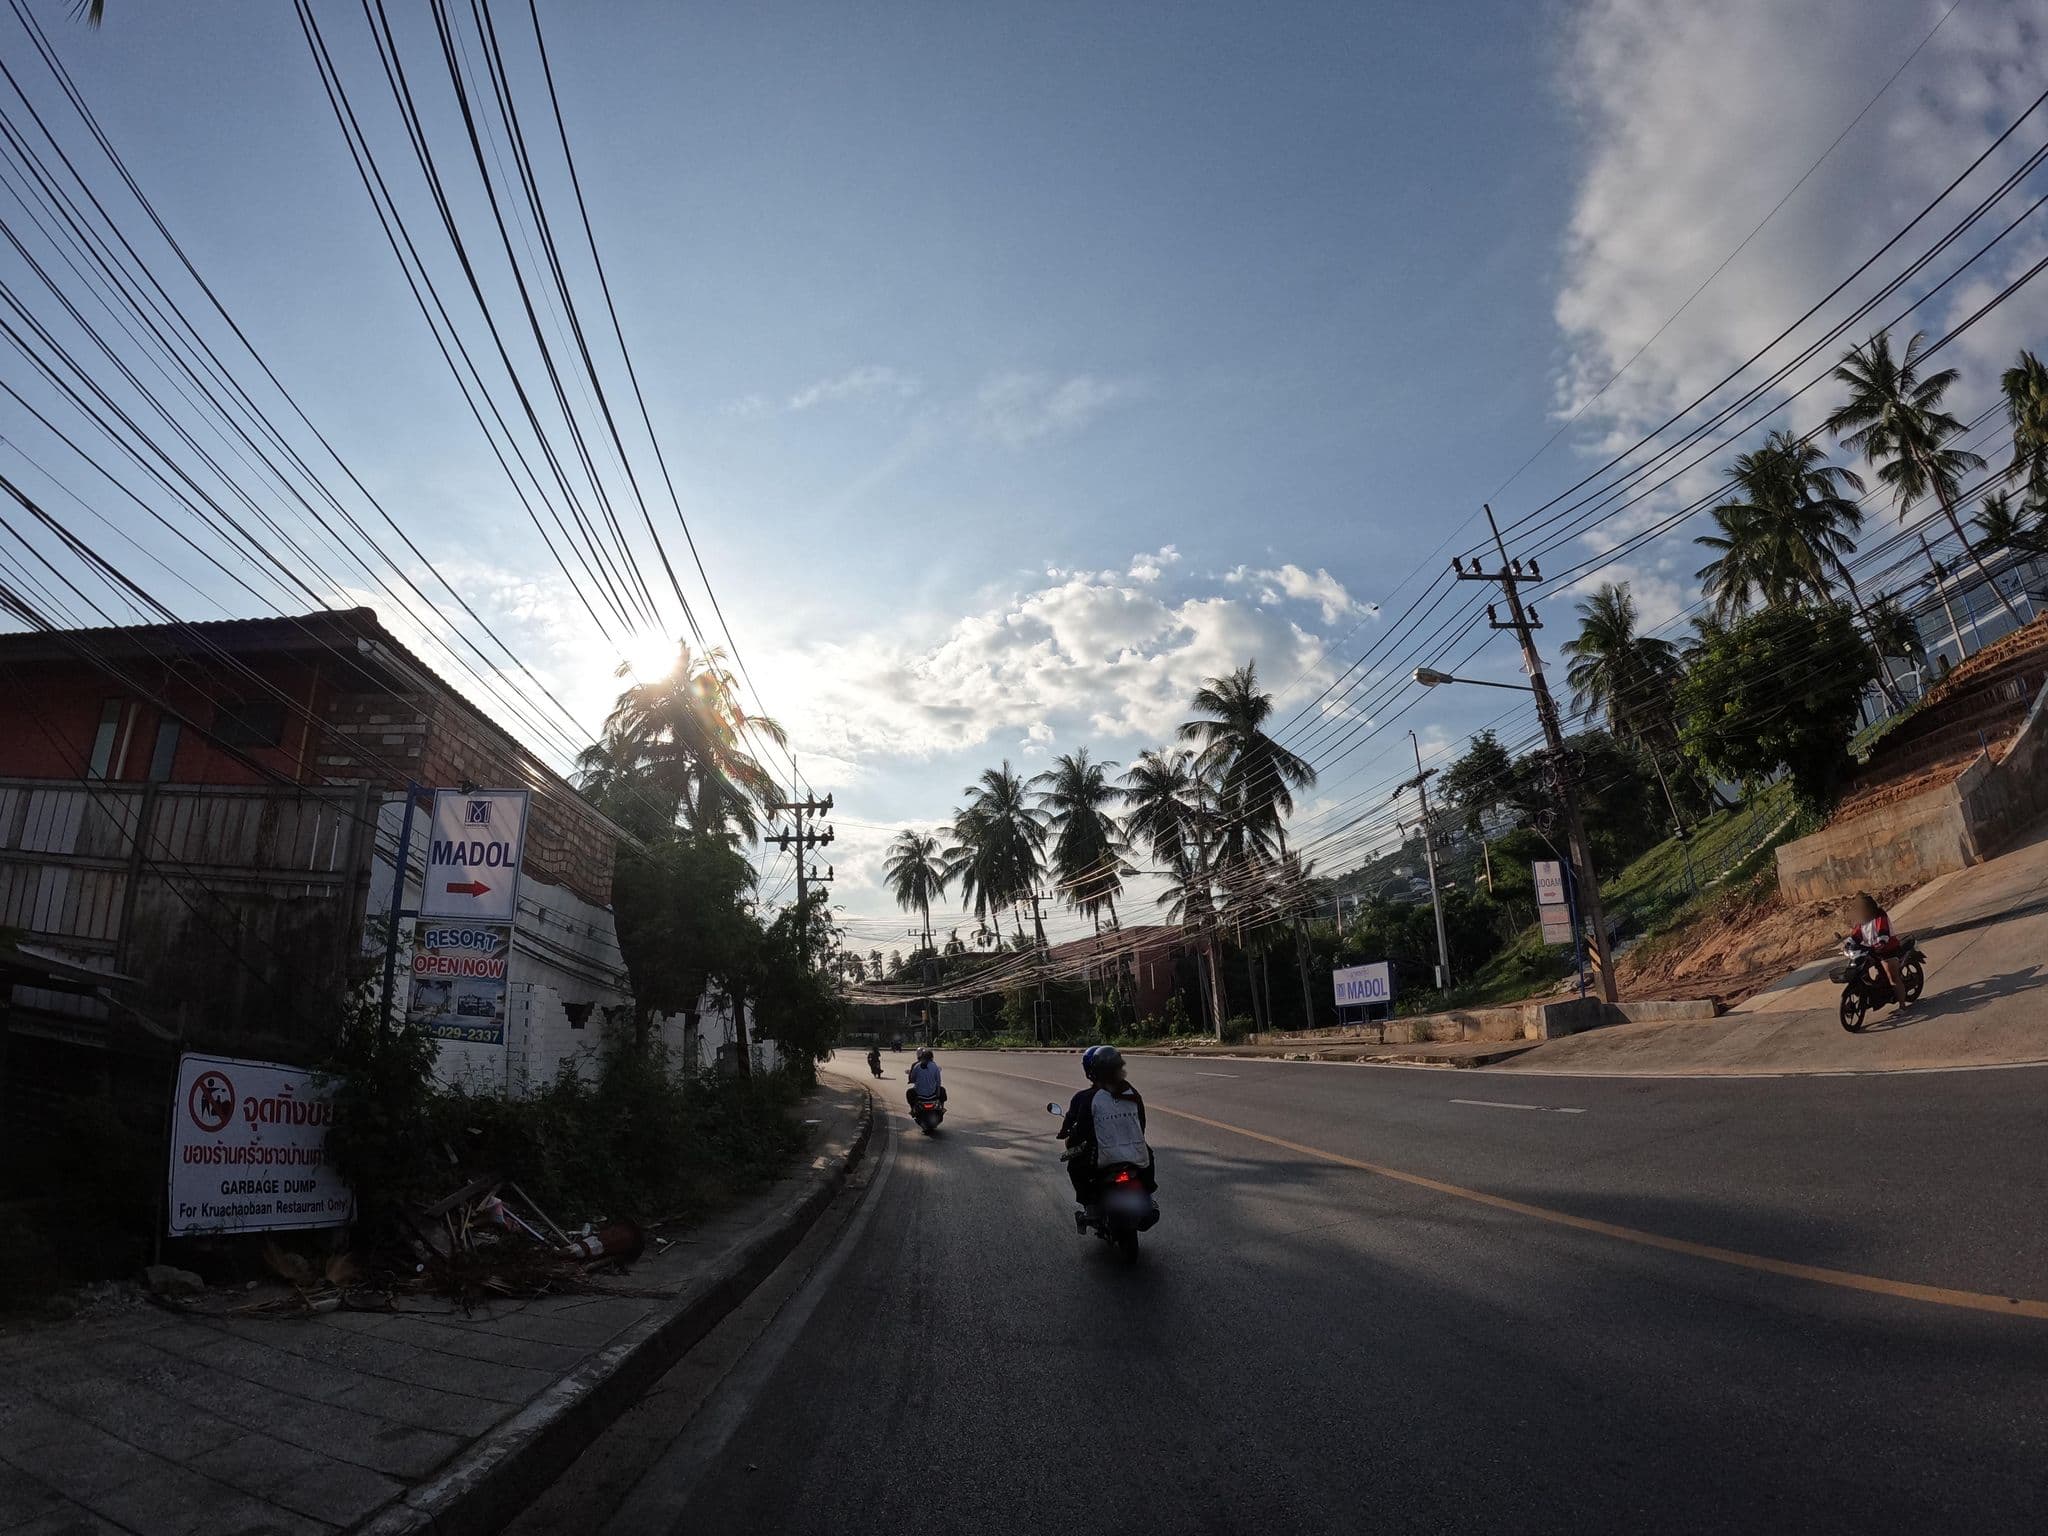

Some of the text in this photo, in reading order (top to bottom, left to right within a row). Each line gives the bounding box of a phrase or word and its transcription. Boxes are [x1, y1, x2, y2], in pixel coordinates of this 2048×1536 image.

[431, 841, 515, 867] MADOL
[425, 930, 498, 951] RESORT
[414, 955, 506, 978] OPEN NOW
[1347, 978, 1388, 1000] MADOL
[408, 1022, 499, 1042] -029-2337
[243, 1084, 335, 1131] จุดทิ้งขย
[221, 1180, 316, 1195] GARBAGE DUMP
[179, 1203, 197, 1218] For
[202, 1202, 272, 1217] Kruachaobaan
[276, 1200, 324, 1214] Restaurant
